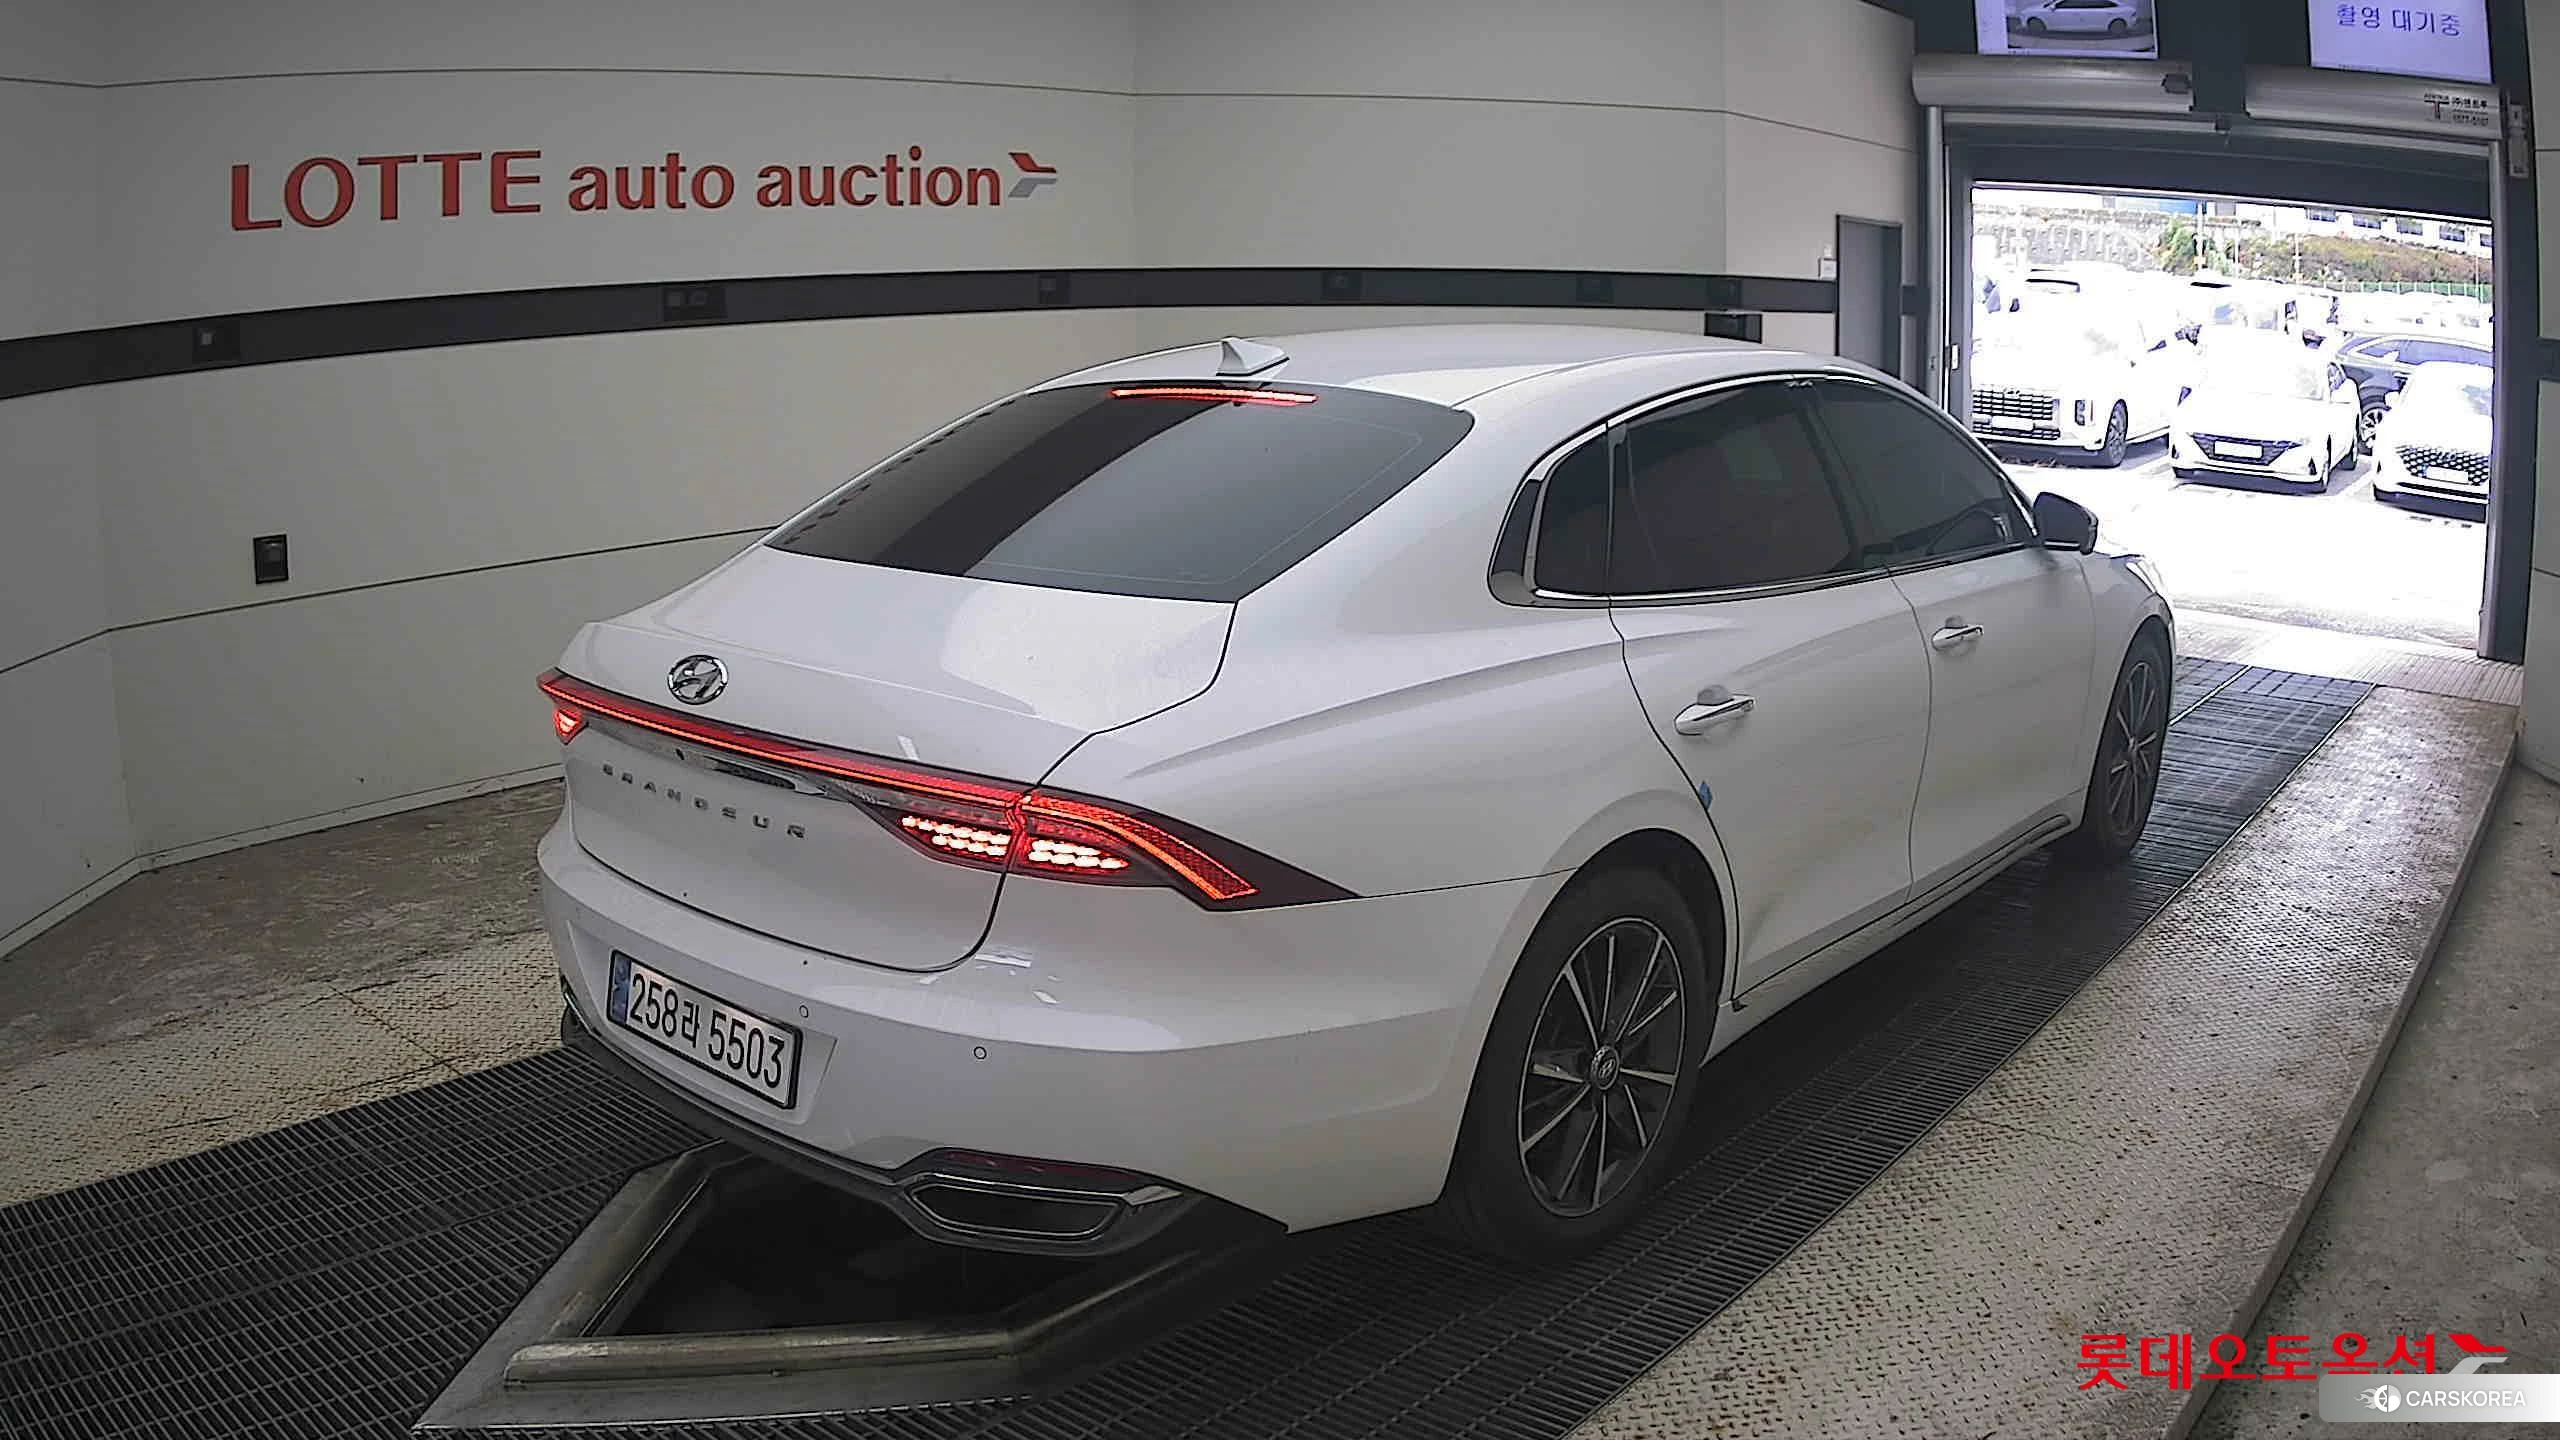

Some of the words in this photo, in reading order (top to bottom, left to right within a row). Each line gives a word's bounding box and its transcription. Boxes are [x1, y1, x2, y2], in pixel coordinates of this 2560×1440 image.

[2338, 4, 2380, 29] 촬영
[2392, 9, 2460, 36] 대기중
[230, 150, 540, 230] LOTTE
[568, 153, 735, 210] auto
[756, 146, 1001, 208] auction
[602, 763, 806, 839] GRANDEUR
[630, 973, 700, 1048] 258라
[708, 1008, 785, 1088] 5503
